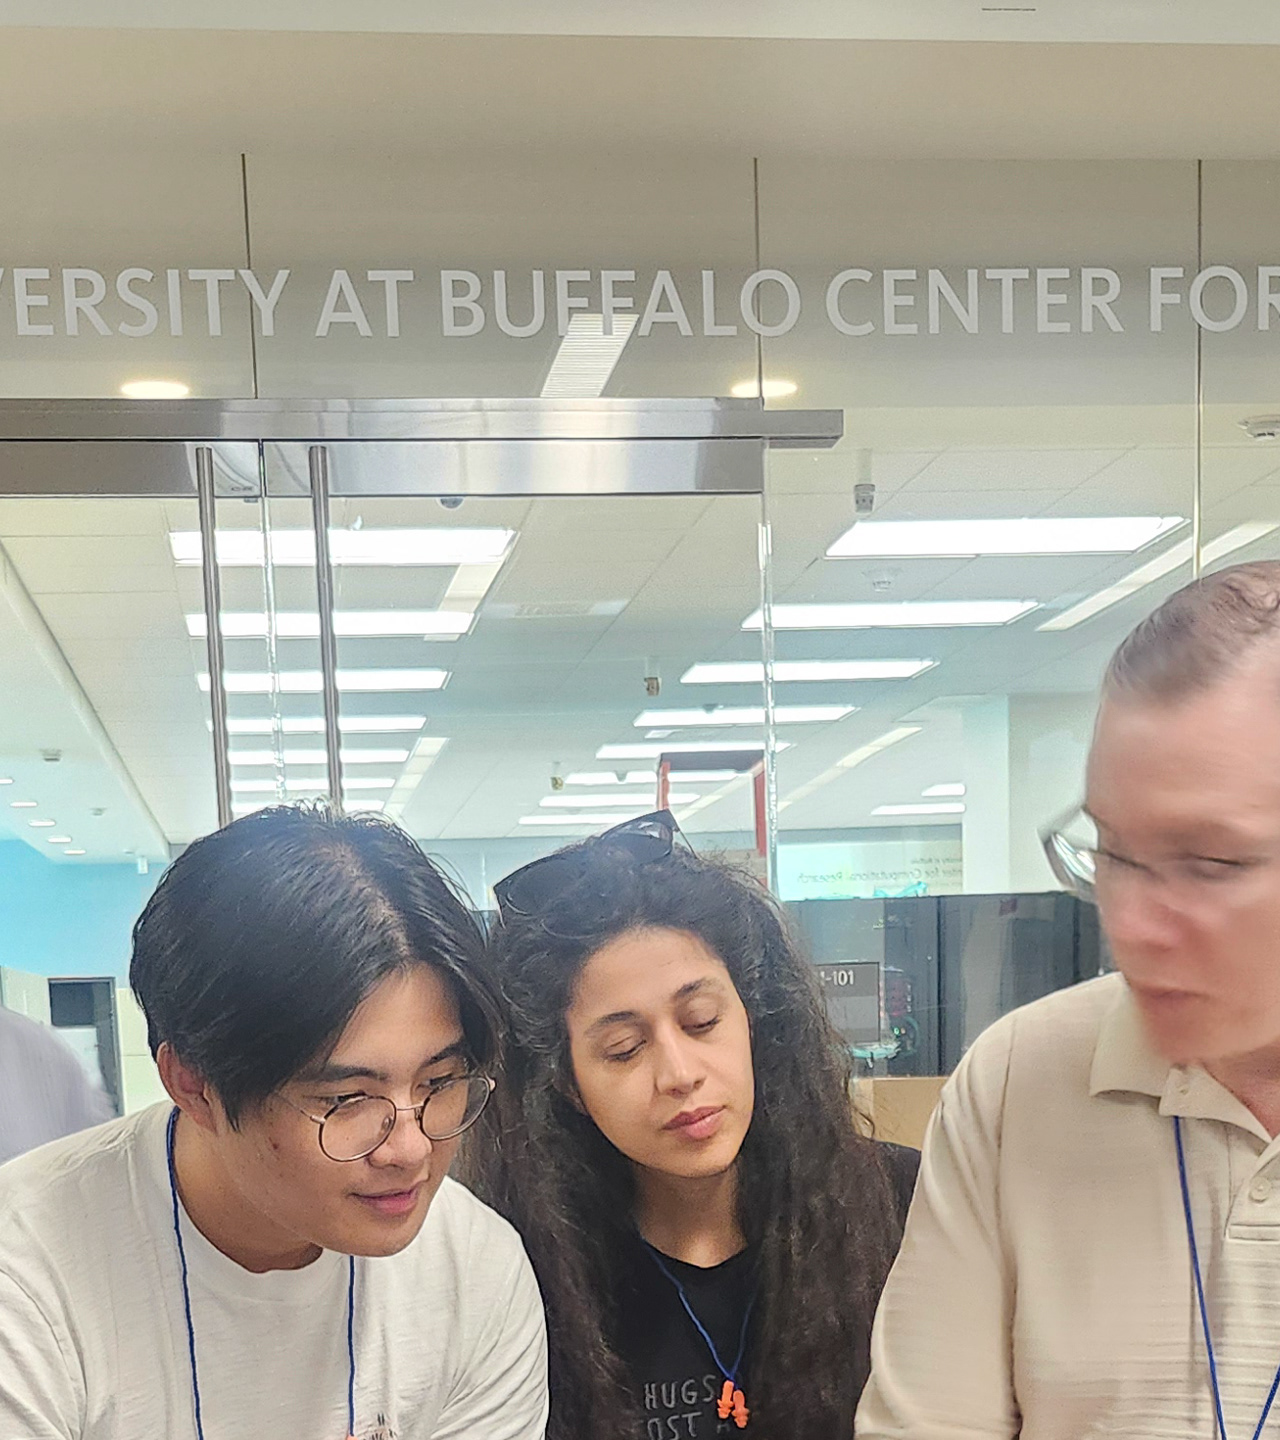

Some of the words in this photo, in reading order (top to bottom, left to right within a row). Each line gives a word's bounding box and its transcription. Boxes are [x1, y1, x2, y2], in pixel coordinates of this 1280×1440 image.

[316, 269, 415, 338] AT
[440, 268, 803, 339] BUFFALO
[825, 265, 1124, 337] CENTER
[644, 1374, 716, 1411] HUGS
